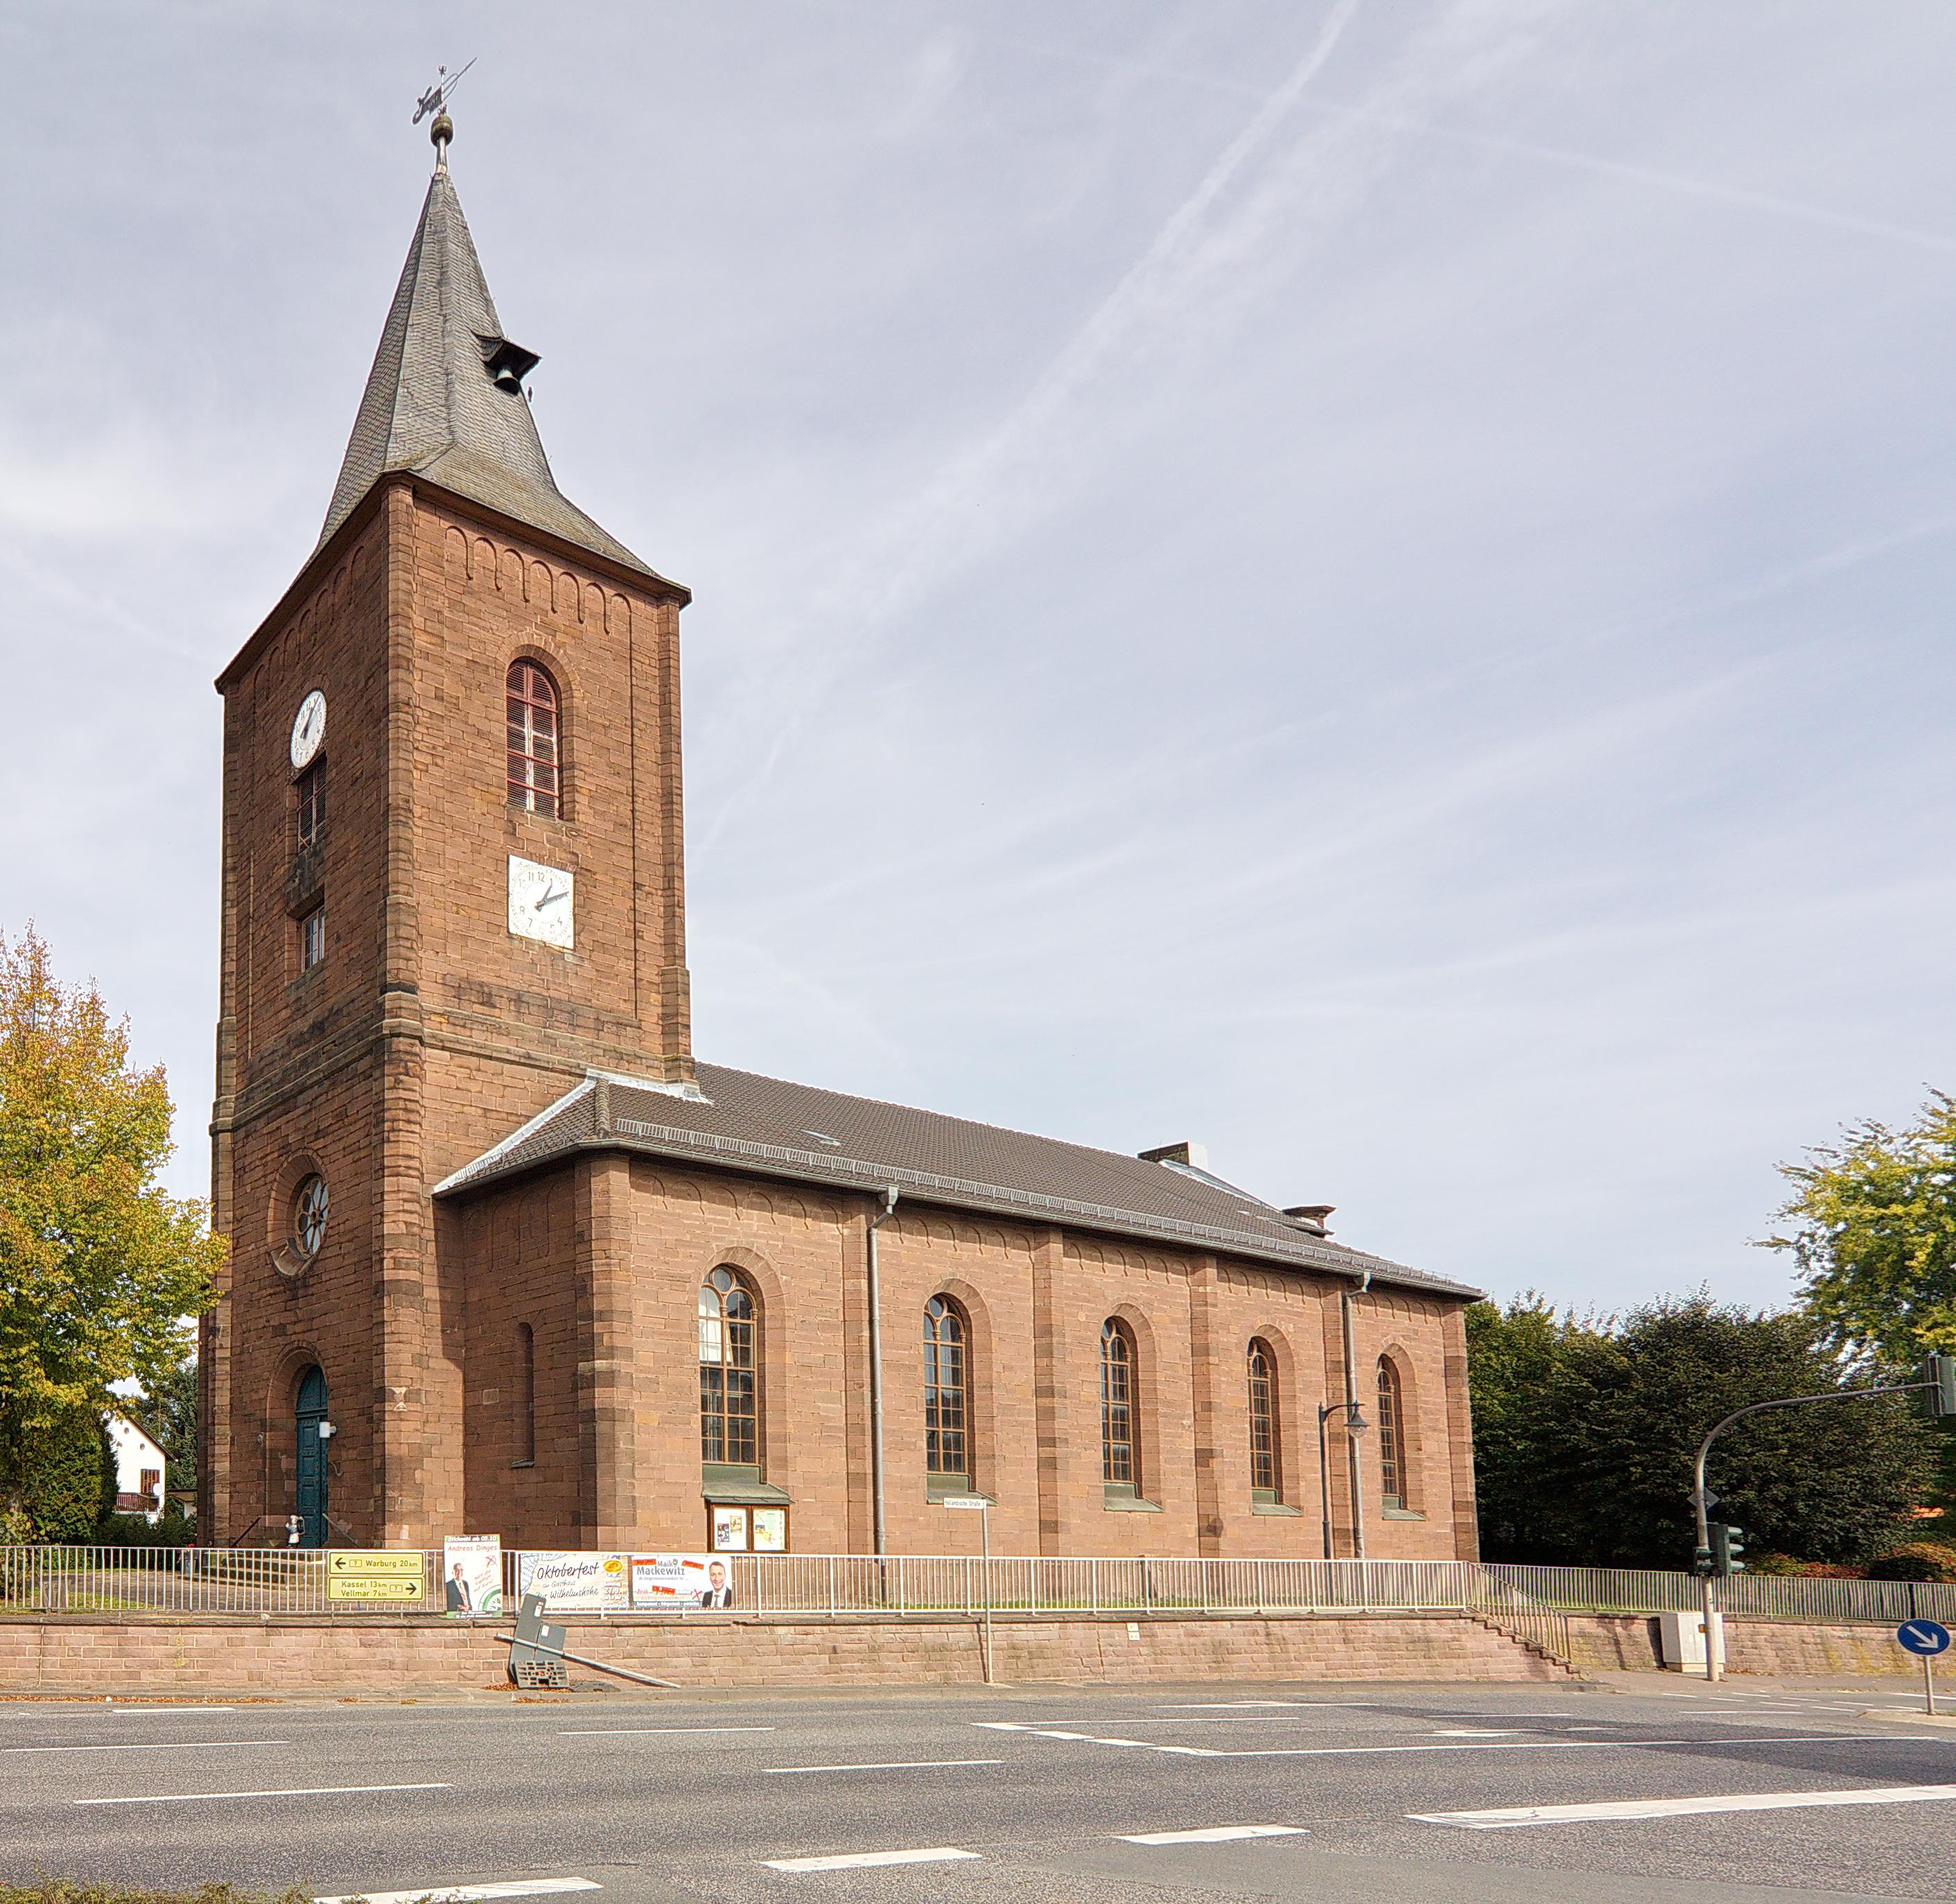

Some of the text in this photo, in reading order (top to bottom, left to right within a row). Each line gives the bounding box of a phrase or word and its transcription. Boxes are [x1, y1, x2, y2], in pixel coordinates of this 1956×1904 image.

[306, 701, 311, 712] 12
[301, 710, 305, 721] 11
[318, 712, 322, 722] 3
[316, 726, 320, 735] 4
[311, 739, 316, 749] 5
[528, 871, 534, 882] 11
[538, 871, 545, 882] 12
[519, 879, 527, 889] 10
[519, 905, 525, 916] 8
[527, 918, 533, 928] 7
[557, 916, 563, 927] 4
[550, 924, 555, 934] 5
[476, 1544, 498, 1553] Dinges
[365, 1560, 396, 1569] Warburg
[537, 1562, 600, 1580] Oktoberfest
[636, 1565, 686, 1575] Mackewitz
[550, 1586, 599, 1599] Wilhelmshöhe
